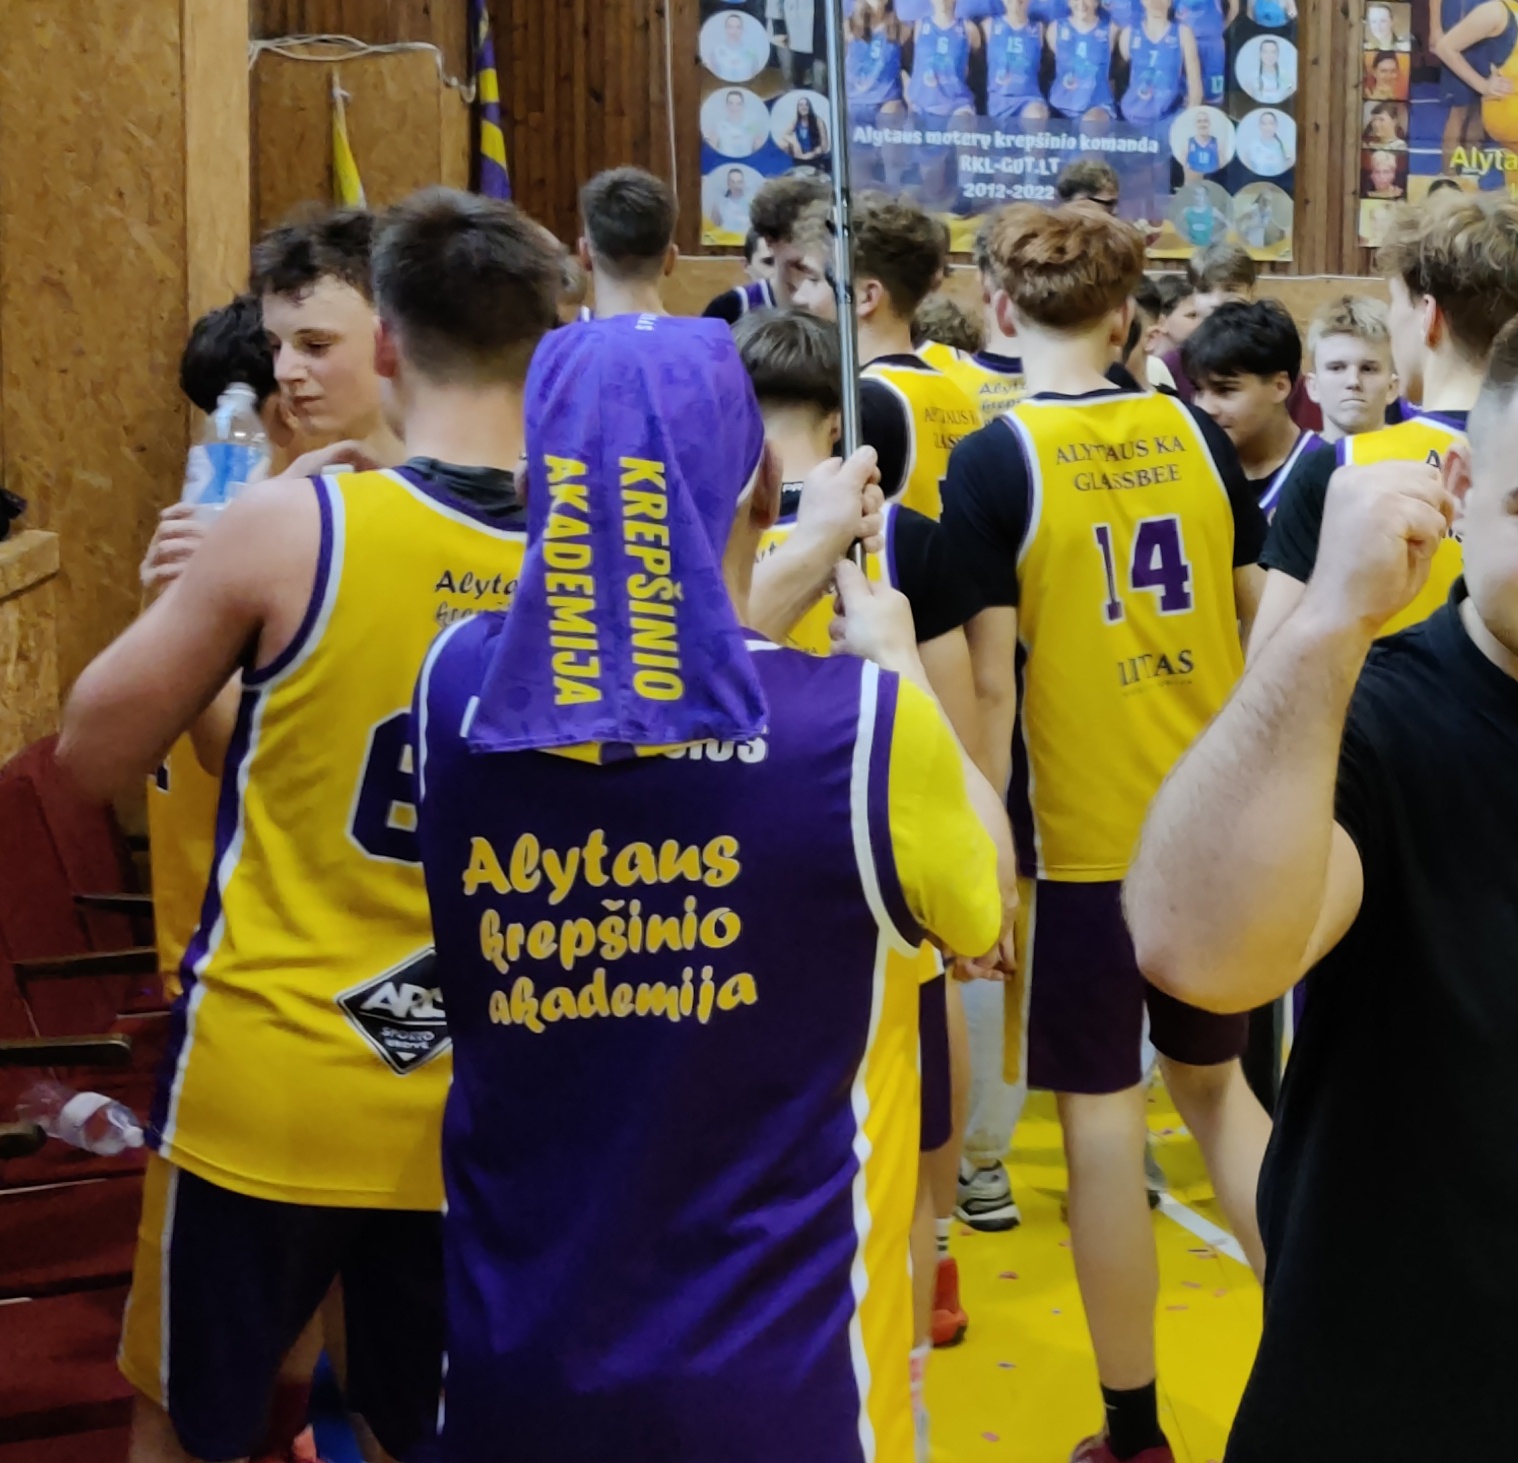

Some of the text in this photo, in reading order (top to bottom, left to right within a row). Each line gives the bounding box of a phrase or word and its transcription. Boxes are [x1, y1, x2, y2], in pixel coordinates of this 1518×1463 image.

[853, 126, 922, 147] Alytaus
[1080, 136, 1159, 154] komanda
[1153, 435, 1187, 455] KA
[542, 453, 603, 706] AKADEMIJA
[618, 456, 685, 702] KREPŠINIO
[1092, 514, 1195, 626] 14
[463, 829, 741, 905] Alytaus
[478, 894, 742, 974] krepšinio
[488, 964, 757, 1033] akademija
